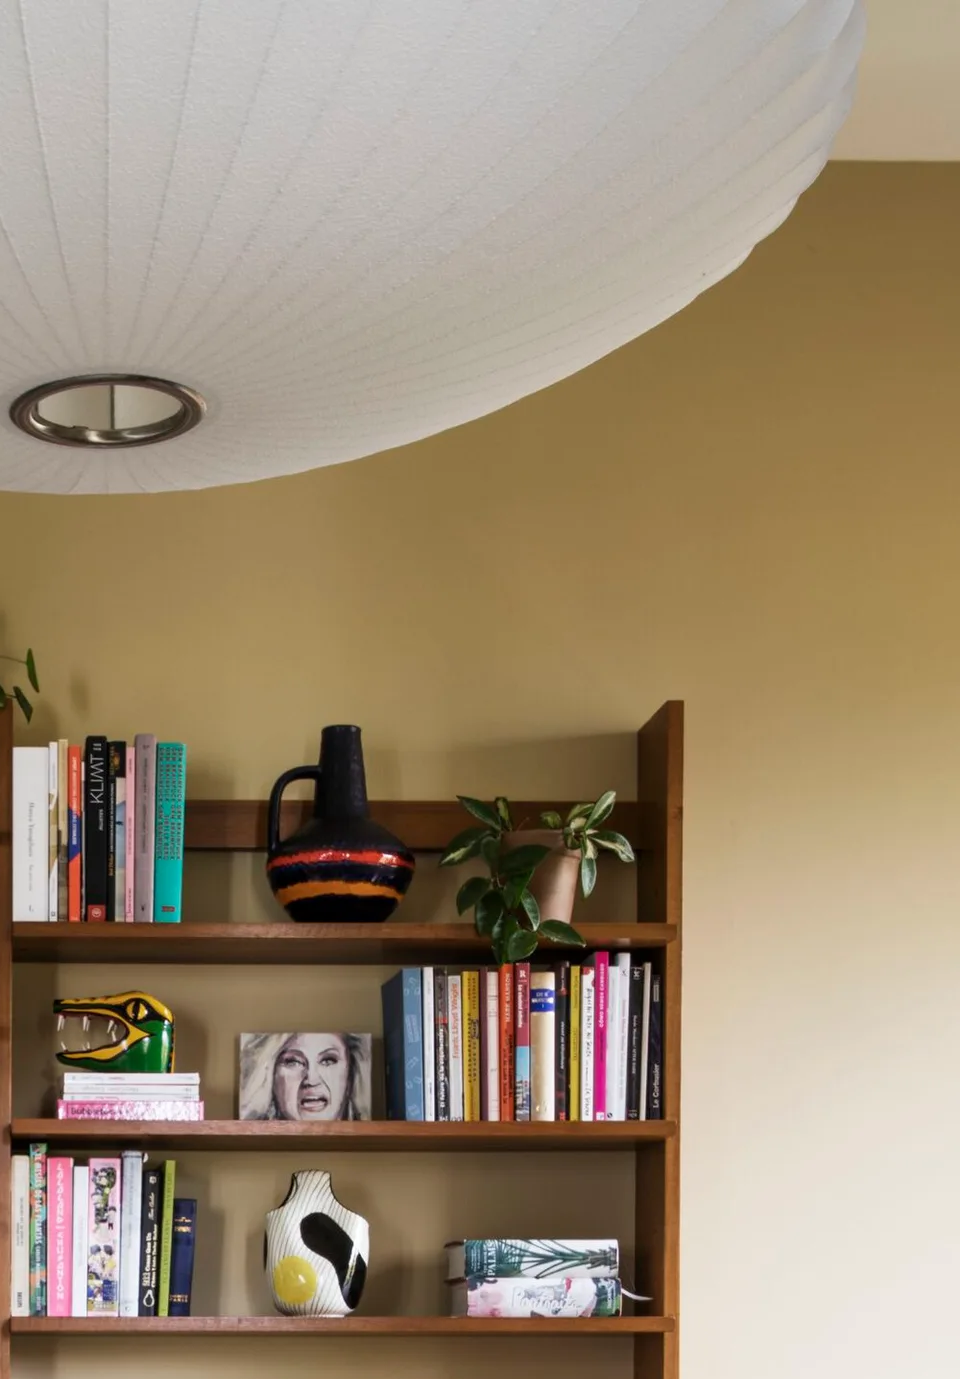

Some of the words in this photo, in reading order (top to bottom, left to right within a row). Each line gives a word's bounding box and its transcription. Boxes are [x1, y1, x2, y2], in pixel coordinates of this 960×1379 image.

[90, 753, 104, 804] KLIMT
[450, 983, 458, 1009] Wright
[451, 1013, 459, 1034] Lloyd
[653, 1099, 660, 1108] Le
[487, 1241, 496, 1275] PALMS
